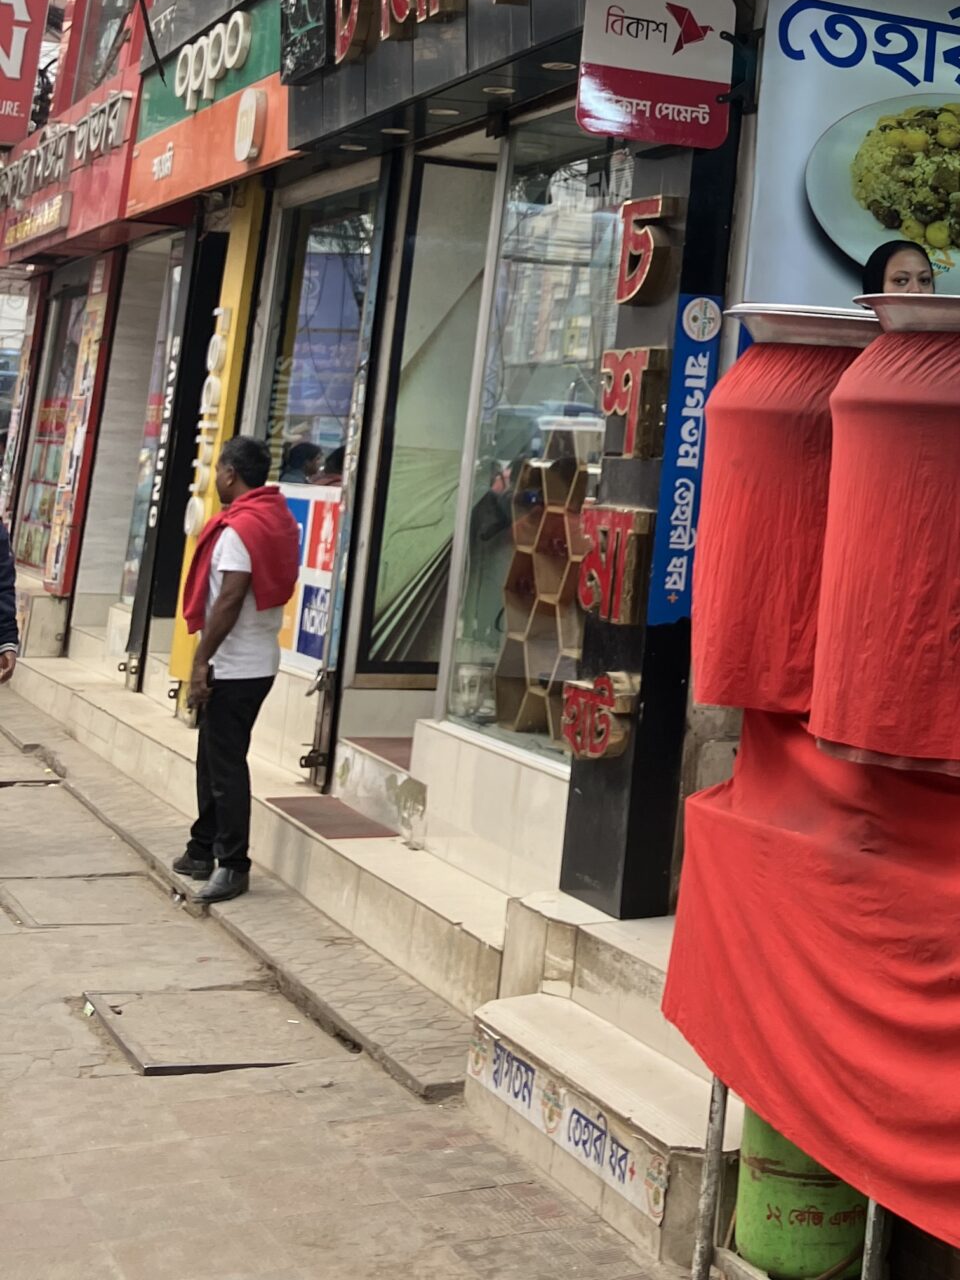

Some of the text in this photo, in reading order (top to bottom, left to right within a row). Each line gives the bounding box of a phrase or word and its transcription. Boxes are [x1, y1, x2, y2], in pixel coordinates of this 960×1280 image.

[605, 5, 668, 43] বিকাশ
[174, 10, 250, 112] oppo
[654, 103, 710, 125] পেমেন্ট
[147, 335, 181, 529] SAMSUNG
[669, 477, 697, 551] তেহারী
[664, 556, 688, 592] ঘর
[493, 1038, 536, 1110] স্বাগতম
[568, 1108, 607, 1168] তেহারী
[609, 1136, 630, 1185] ঘর
